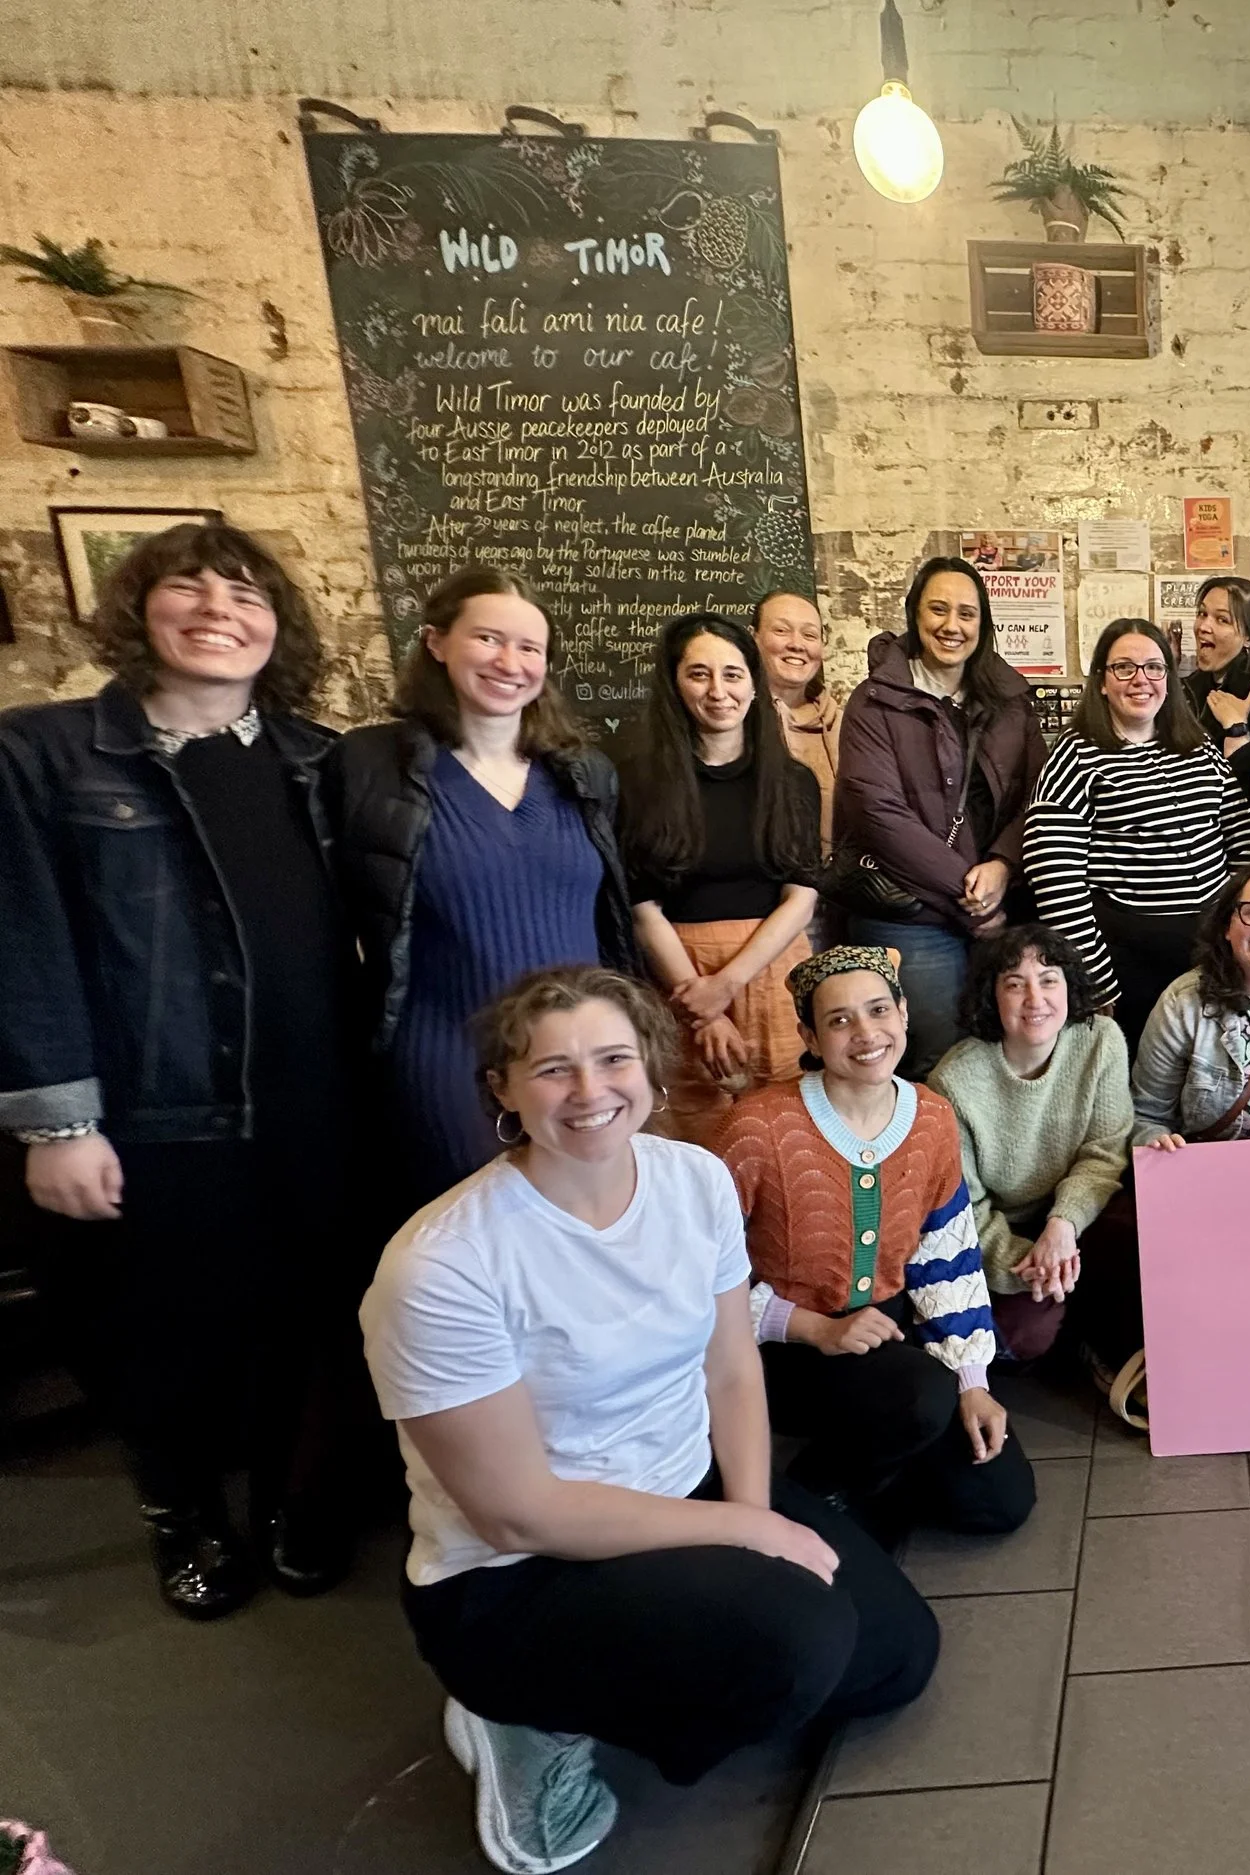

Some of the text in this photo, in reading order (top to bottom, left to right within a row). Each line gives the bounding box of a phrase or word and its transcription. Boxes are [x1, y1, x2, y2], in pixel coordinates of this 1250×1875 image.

[412, 297, 723, 339] mai fali ami nia cafe!
[414, 339, 717, 381] welcome to our cafe!
[436, 378, 721, 420] Wild Timor was founded by
[406, 410, 709, 444] four Aussie peacekeepers deployed
[419, 437, 727, 469] to East Timor in 2012 as part of a
[441, 458, 784, 495] longstanding friendship between Australia
[450, 489, 481, 511] and
[486, 489, 528, 511] East
[1198, 504, 1217, 513] KIDS
[422, 516, 468, 542] After
[473, 516, 493, 535] 30
[493, 519, 530, 541] years
[534, 513, 551, 538] of
[612, 512, 637, 535] the
[642, 516, 681, 542] coffee
[685, 521, 727, 548] planted
[1198, 513, 1218, 521] YOGA
[397, 540, 454, 562] hundreds
[475, 541, 510, 566] years
[510, 547, 534, 568] ago
[537, 540, 554, 567] by
[554, 538, 580, 563] the
[581, 538, 652, 569] Portuguese
[657, 550, 685, 563] was
[690, 542, 752, 564] stumbled
[407, 562, 442, 583] upon
[542, 562, 574, 587] very
[585, 561, 642, 582] soldiers
[648, 564, 661, 581] in
[661, 563, 688, 584] the
[696, 566, 747, 585] remote
[1024, 576, 1057, 588] YOUR
[581, 594, 611, 616] with
[618, 593, 700, 622] independent
[704, 592, 757, 616] farmers
[575, 616, 664, 648] coffee that
[1008, 624, 1026, 633] CAN
[1029, 624, 1049, 633] HELP
[560, 634, 655, 660] helps support
